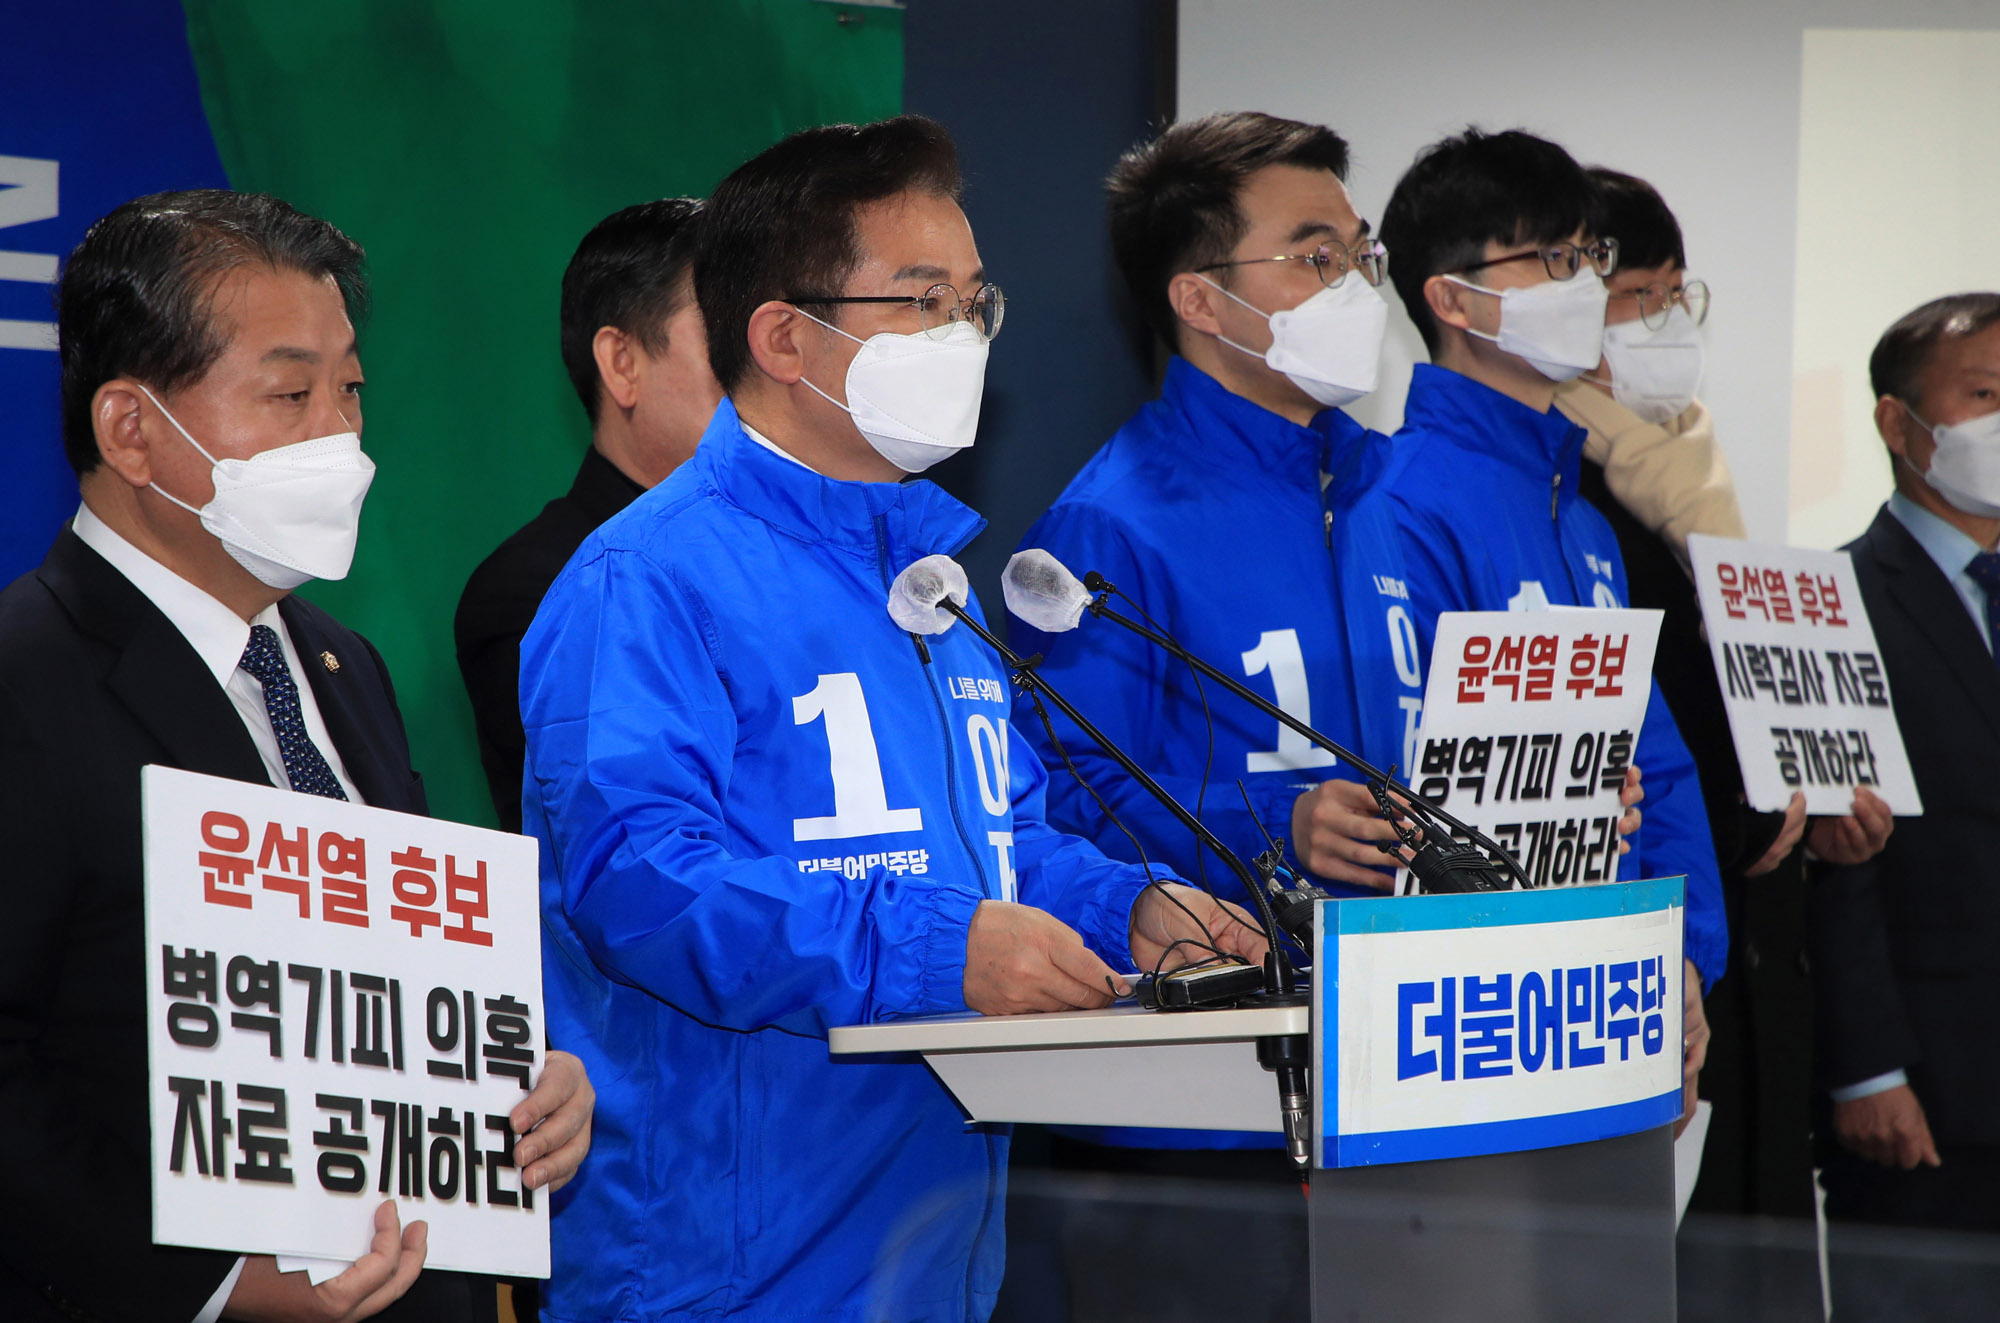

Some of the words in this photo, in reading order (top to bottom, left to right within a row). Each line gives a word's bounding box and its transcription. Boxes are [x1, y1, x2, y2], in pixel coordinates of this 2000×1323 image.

[1717, 562, 1795, 624] 윤석열
[1795, 570, 1848, 628] 후보
[1241, 628, 1337, 773] 1
[1456, 635, 1560, 704] 윤석열
[1565, 633, 1629, 700] 후보
[1722, 641, 1828, 707] 시력검사
[1824, 651, 1890, 708] 자료
[791, 672, 923, 842] 1
[1418, 733, 1562, 806] 병역기피
[1564, 729, 1633, 797] 의혹
[1770, 727, 1880, 787] 공개하라
[198, 810, 370, 928] 윤석열
[390, 845, 494, 947] 후보
[162, 944, 405, 1072] 병역기피
[426, 986, 534, 1091] 의혹
[1397, 955, 1666, 1082] 더불어민주당
[168, 1075, 295, 1183] 자료
